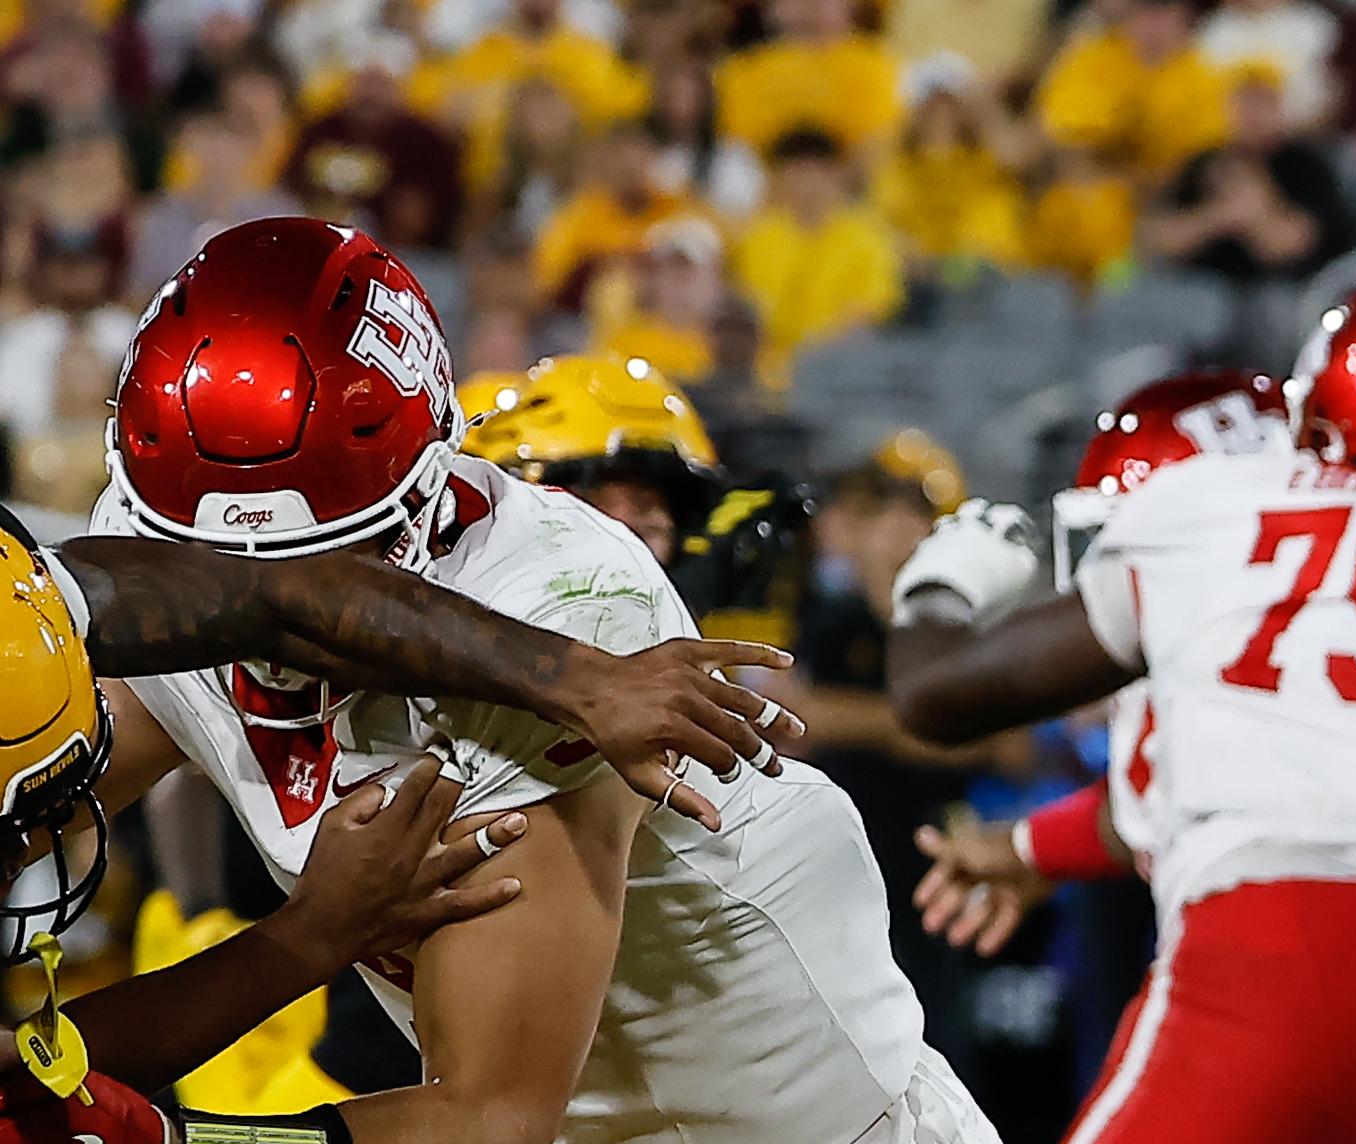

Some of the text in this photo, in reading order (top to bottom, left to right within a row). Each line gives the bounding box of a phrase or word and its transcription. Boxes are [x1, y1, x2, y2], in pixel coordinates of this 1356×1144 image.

[346, 278, 452, 429] UH
[223, 503, 274, 529] Coogs
[286, 754, 319, 804] UH
